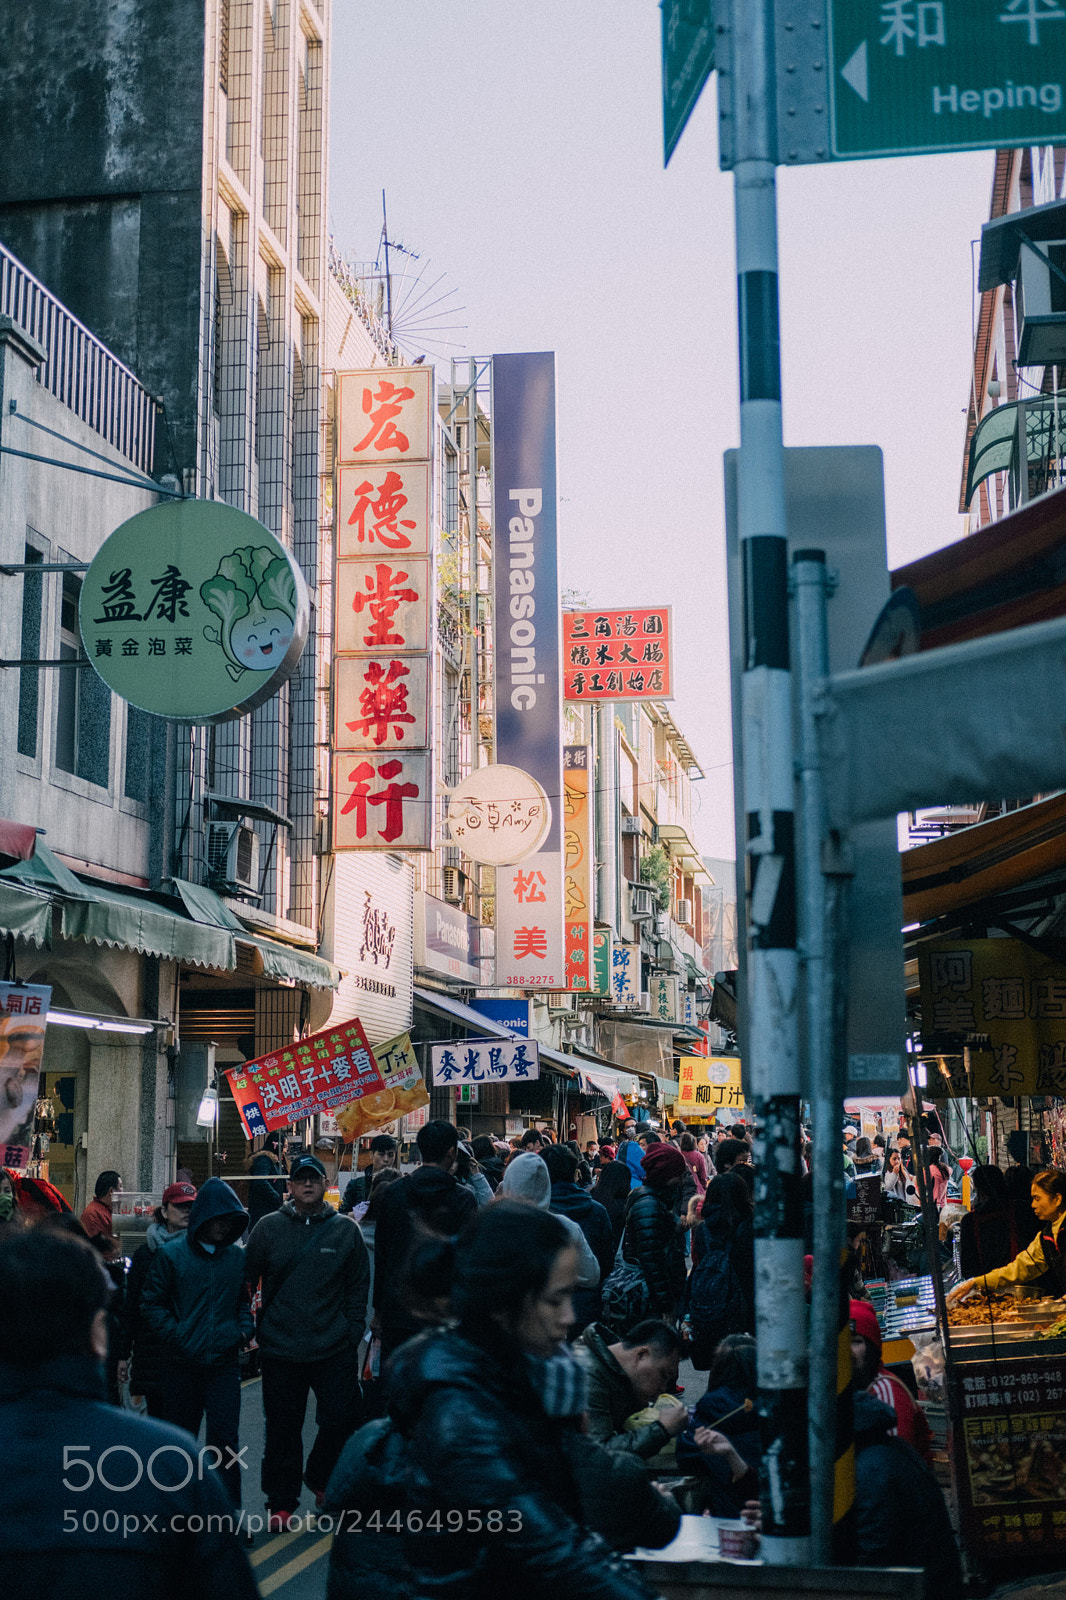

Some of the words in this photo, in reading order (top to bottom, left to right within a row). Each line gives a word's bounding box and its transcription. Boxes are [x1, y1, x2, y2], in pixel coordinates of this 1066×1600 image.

[933, 80, 1063, 118] Heping
[93, 564, 194, 624] 益康
[508, 487, 545, 712] Panasonic
[340, 380, 420, 843] 宏德堂藥行
[569, 614, 663, 640] 三角湯圓
[94, 636, 193, 658] 黃金泡菜
[569, 641, 665, 667] 糯米大腸
[569, 668, 664, 695] 手工創始店
[512, 869, 548, 961] 松美
[436, 909, 470, 953] Panasonic
[506, 975, 555, 985] 388-2275
[494, 1017, 528, 1028] sonic
[695, 1084, 744, 1105] 柳丁汁
